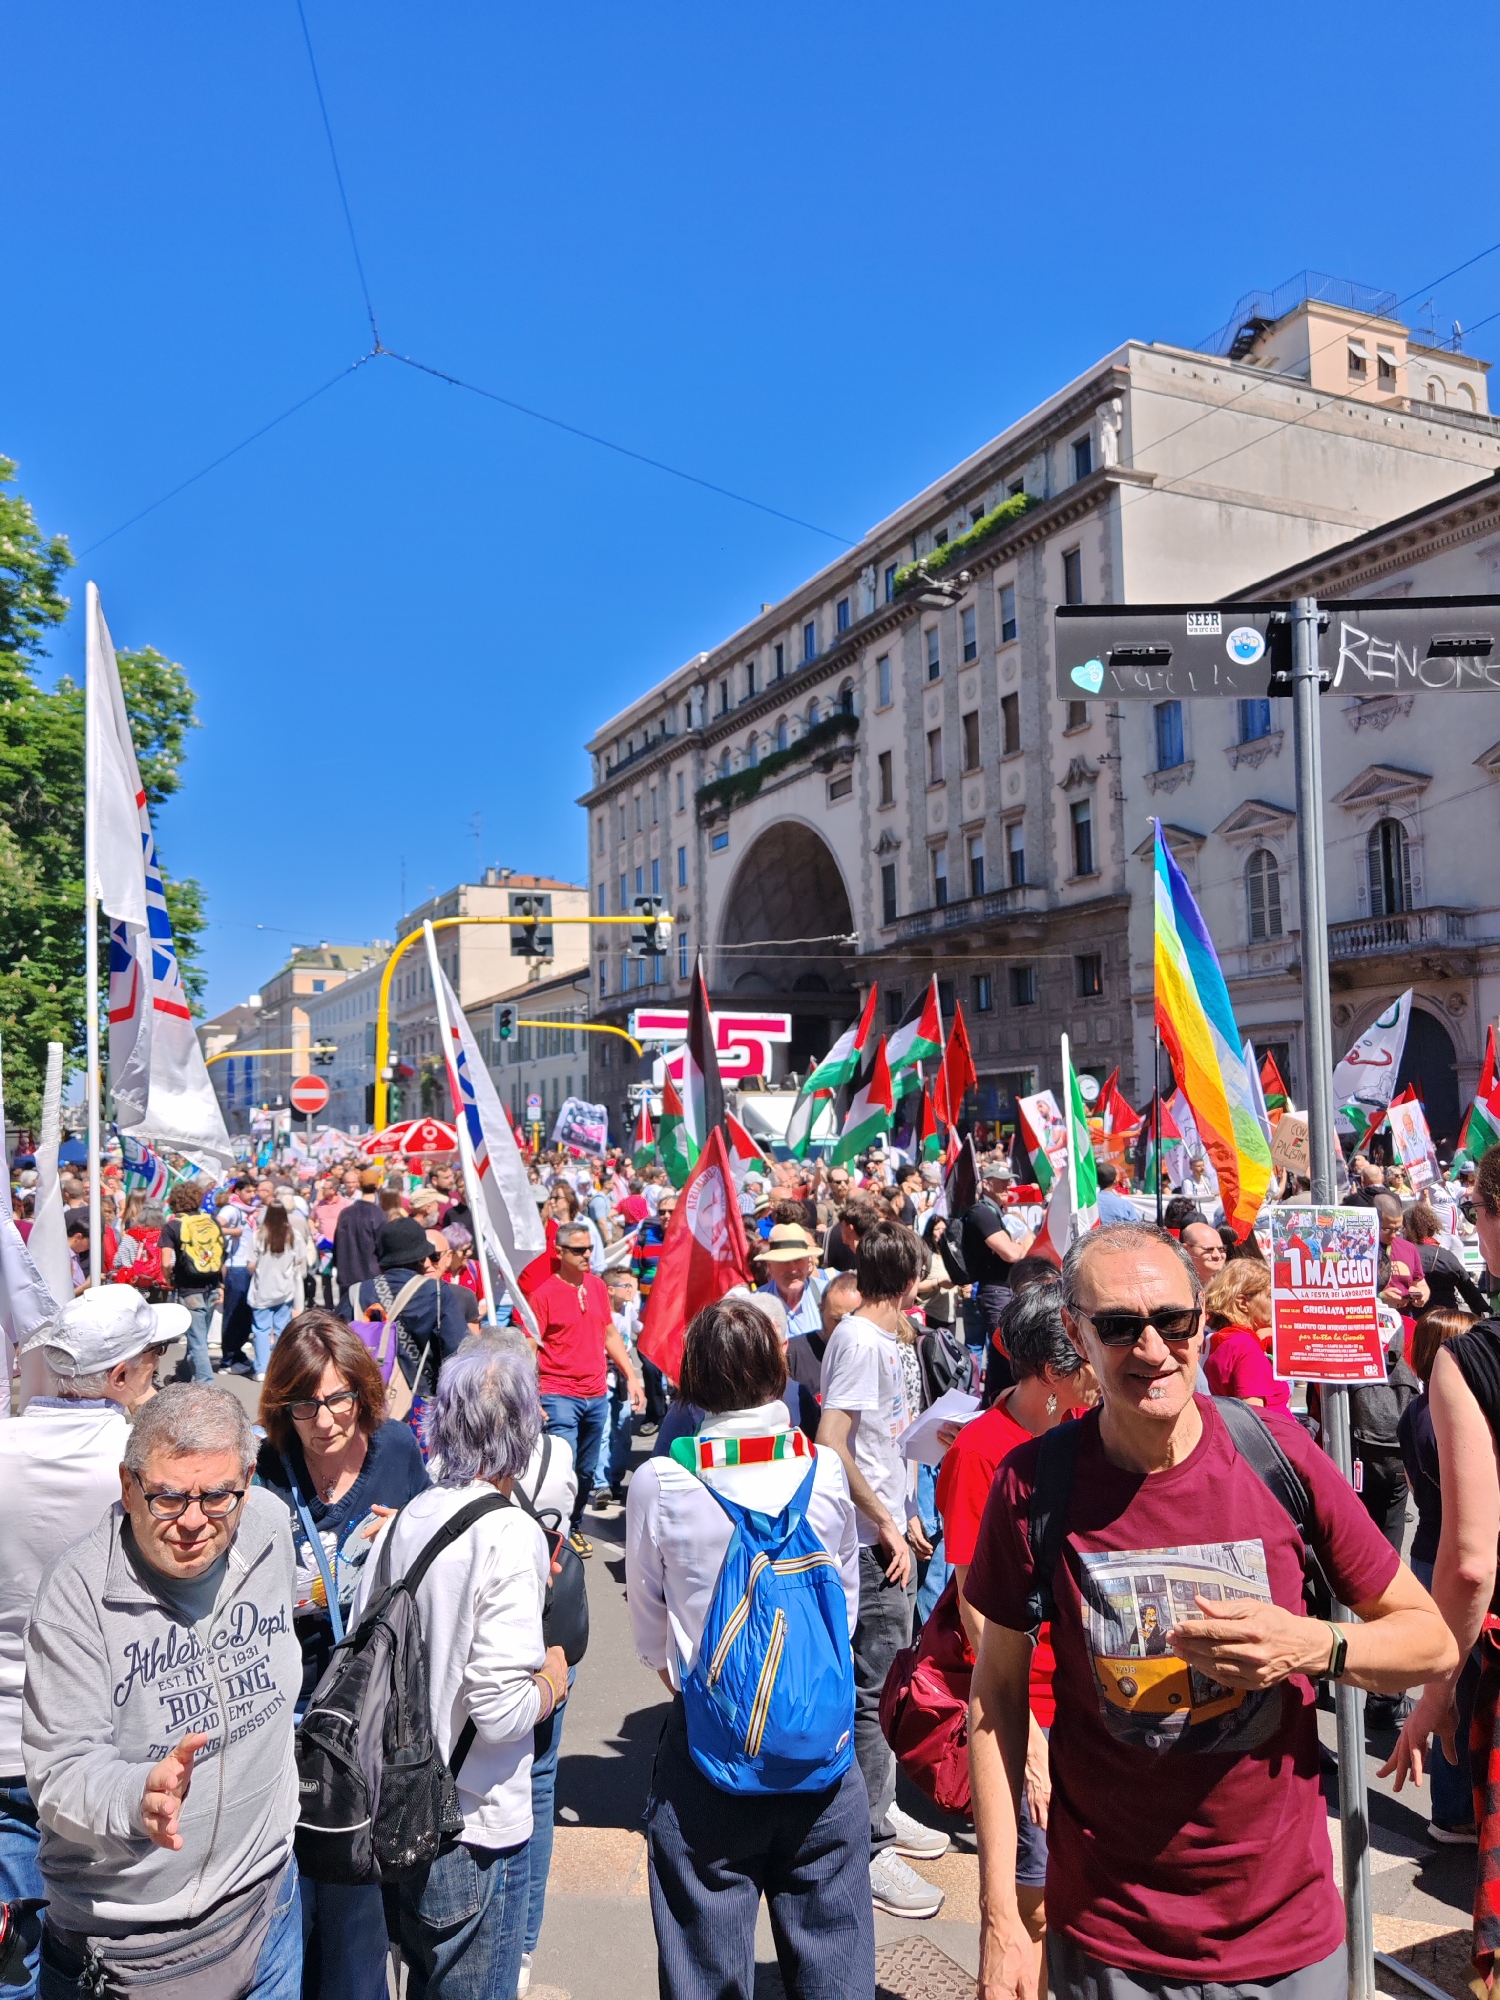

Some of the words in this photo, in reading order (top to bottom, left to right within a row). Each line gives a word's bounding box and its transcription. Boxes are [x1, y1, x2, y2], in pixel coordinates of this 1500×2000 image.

[1188, 613, 1220, 626] SEER
[1284, 1248, 1303, 1286] 1
[1305, 1259, 1372, 1290] MAGGIO
[1303, 1305, 1345, 1315] GRIGLIATA
[1345, 1305, 1374, 1314] POPOLARE
[1341, 1289, 1373, 1298] LAVORATORI
[230, 1601, 290, 1647] Dept.
[158, 1675, 185, 1692] EST.
[231, 1645, 260, 1668] 1931
[165, 1663, 272, 1728] BOXING
[185, 1699, 255, 1736] ACADEMY
[229, 1690, 288, 1745] SESSION
